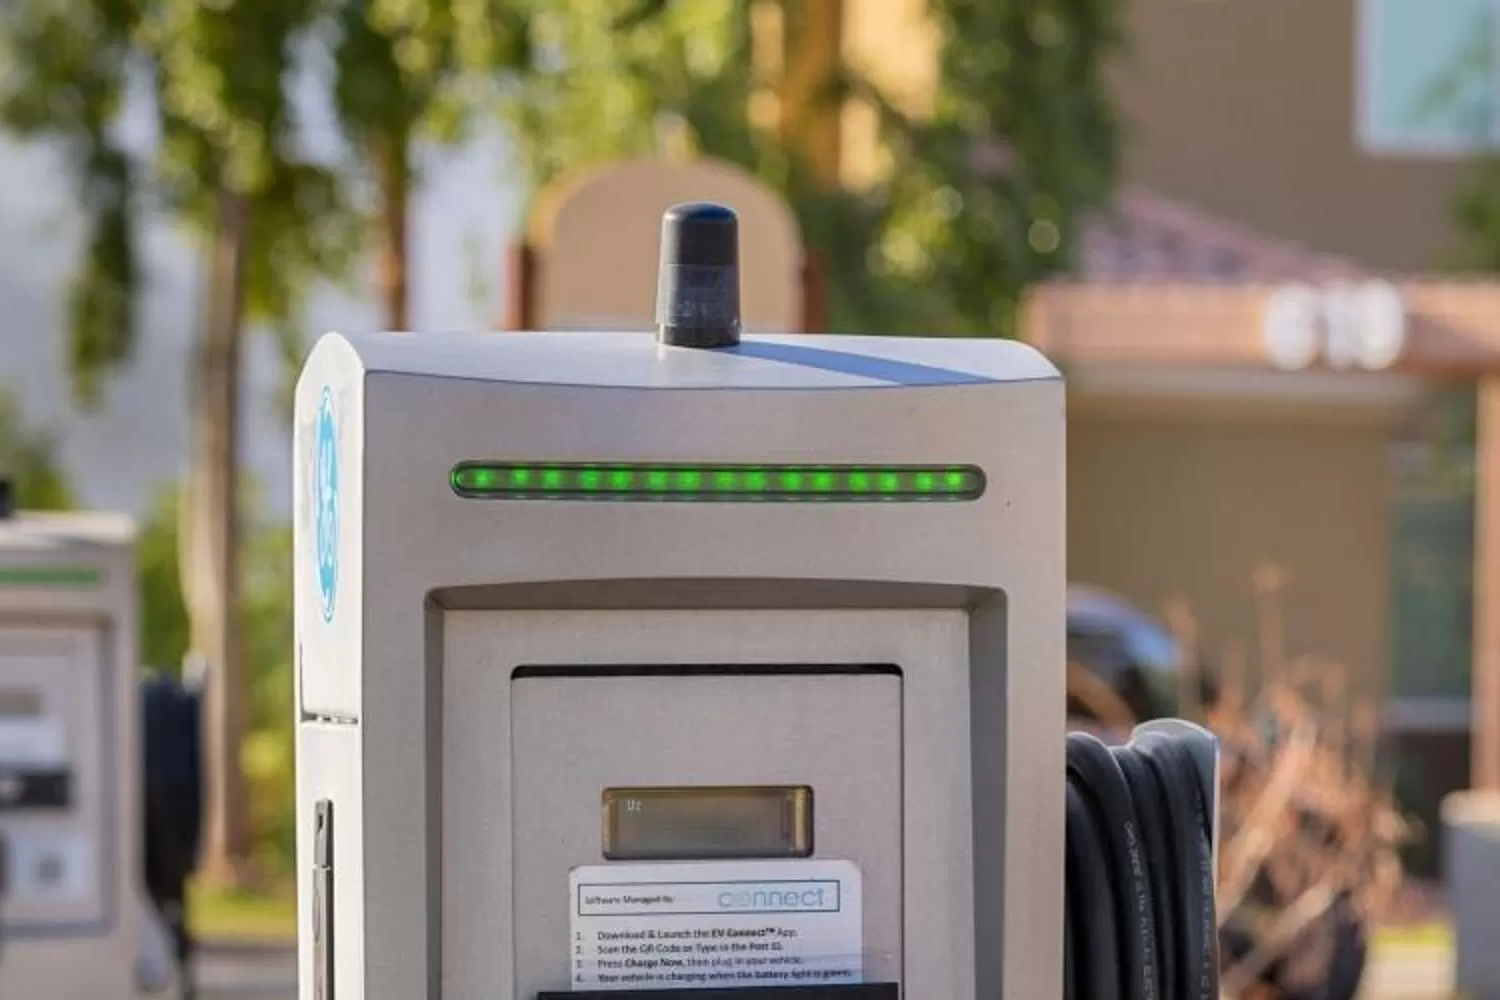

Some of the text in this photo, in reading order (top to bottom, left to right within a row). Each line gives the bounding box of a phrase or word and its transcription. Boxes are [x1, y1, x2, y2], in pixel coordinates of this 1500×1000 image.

[597, 930, 645, 941] Download
[658, 928, 692, 939] Launch
[694, 928, 710, 938] the
[711, 928, 725, 938] EV
[597, 944, 619, 954] Scan
[621, 944, 639, 954] the
[656, 943, 680, 953] Code
[683, 944, 693, 953] or
[695, 943, 716, 954] Type
[731, 942, 747, 951] the
[750, 941, 769, 951] Port
[597, 959, 622, 969] Press
[624, 957, 659, 969] Charge
[687, 957, 709, 967] then
[597, 973, 619, 982] Your
[621, 971, 655, 982] vehicle
[666, 970, 707, 983] charging
[709, 971, 734, 980] when
[736, 970, 752, 979] the
[755, 969, 789, 980] battery
